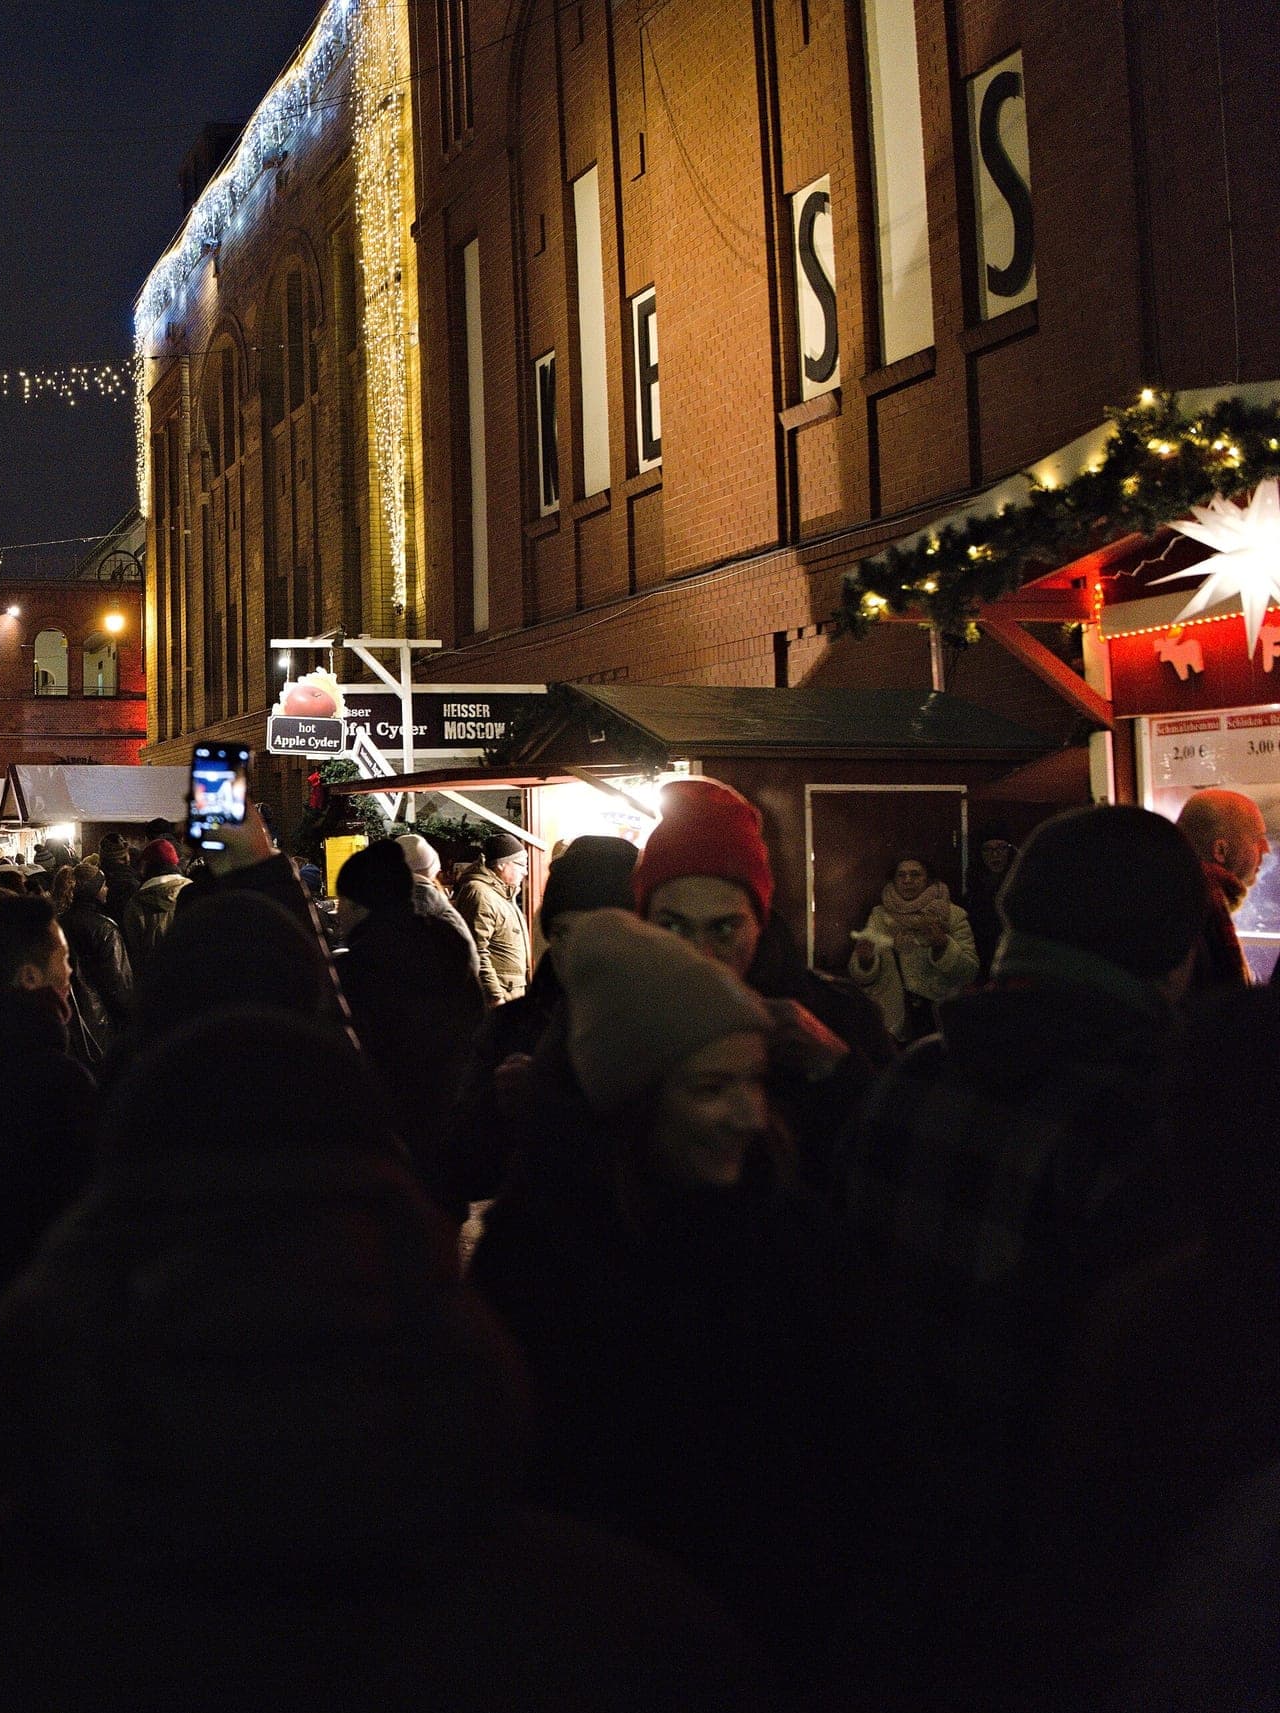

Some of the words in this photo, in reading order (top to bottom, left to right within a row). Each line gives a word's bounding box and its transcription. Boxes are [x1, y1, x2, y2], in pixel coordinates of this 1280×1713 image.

[798, 190, 840, 384] S
[979, 69, 1035, 298] S
[442, 703, 491, 718] HEISSER
[298, 722, 316, 733] hot
[443, 720, 506, 740] MOSCOW
[273, 735, 306, 748] Apple
[307, 736, 340, 750] Cyder
